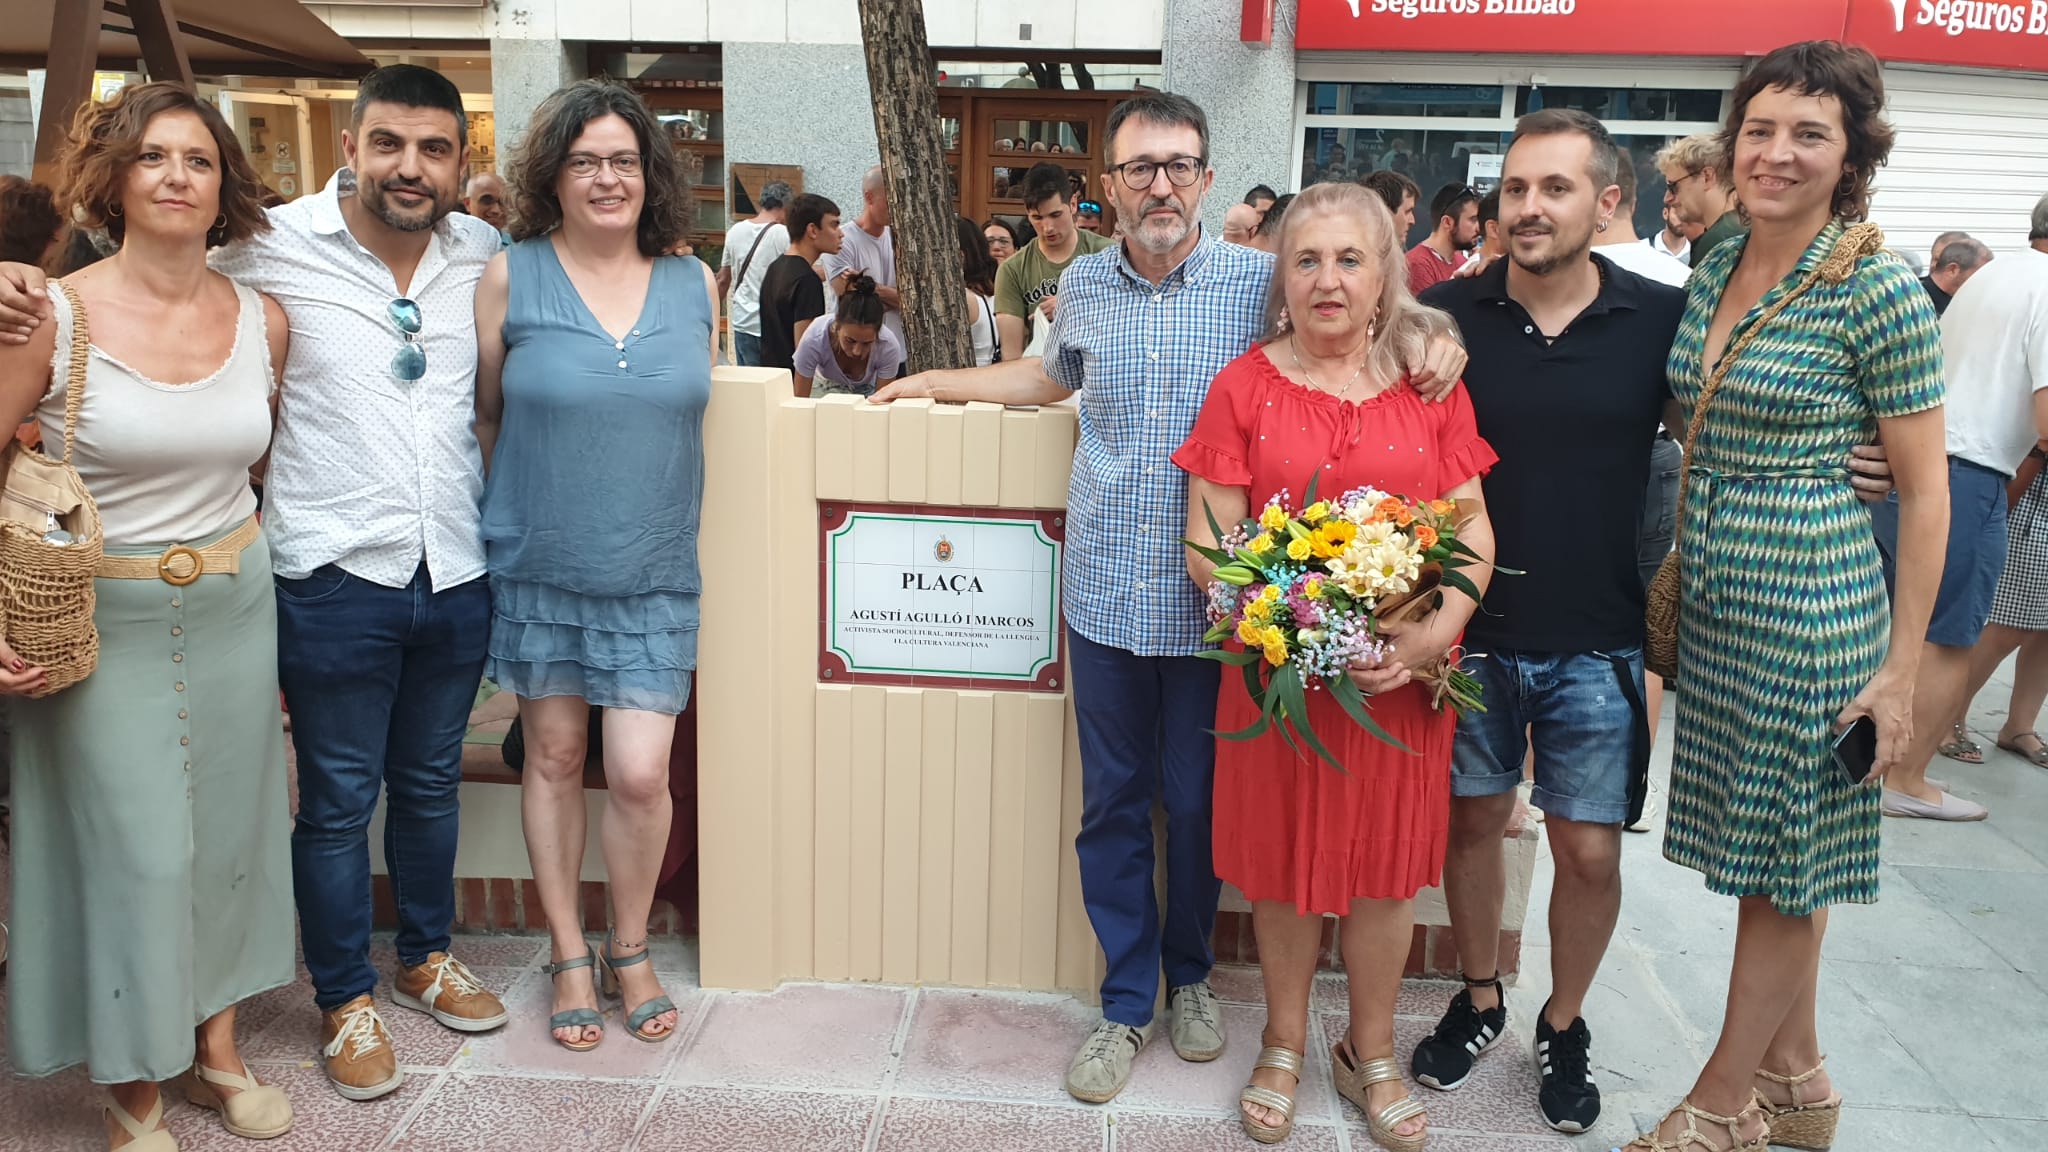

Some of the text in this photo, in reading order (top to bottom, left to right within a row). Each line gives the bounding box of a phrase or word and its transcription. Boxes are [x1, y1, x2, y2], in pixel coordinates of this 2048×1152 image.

[1371, 0, 1576, 19] Seguros Bilbao
[1916, 0, 2026, 36] Seguros
[901, 572, 984, 595] PLAÇA
[849, 608, 1034, 628] AGUSTÍ AGULLÓ I MARCOS
[843, 626, 881, 634] ACTIVISTA
[882, 628, 944, 637] SOCIOCULTURAL,
[945, 631, 982, 639] DEFENSOR
[943, 640, 989, 649] VALENCIANA
